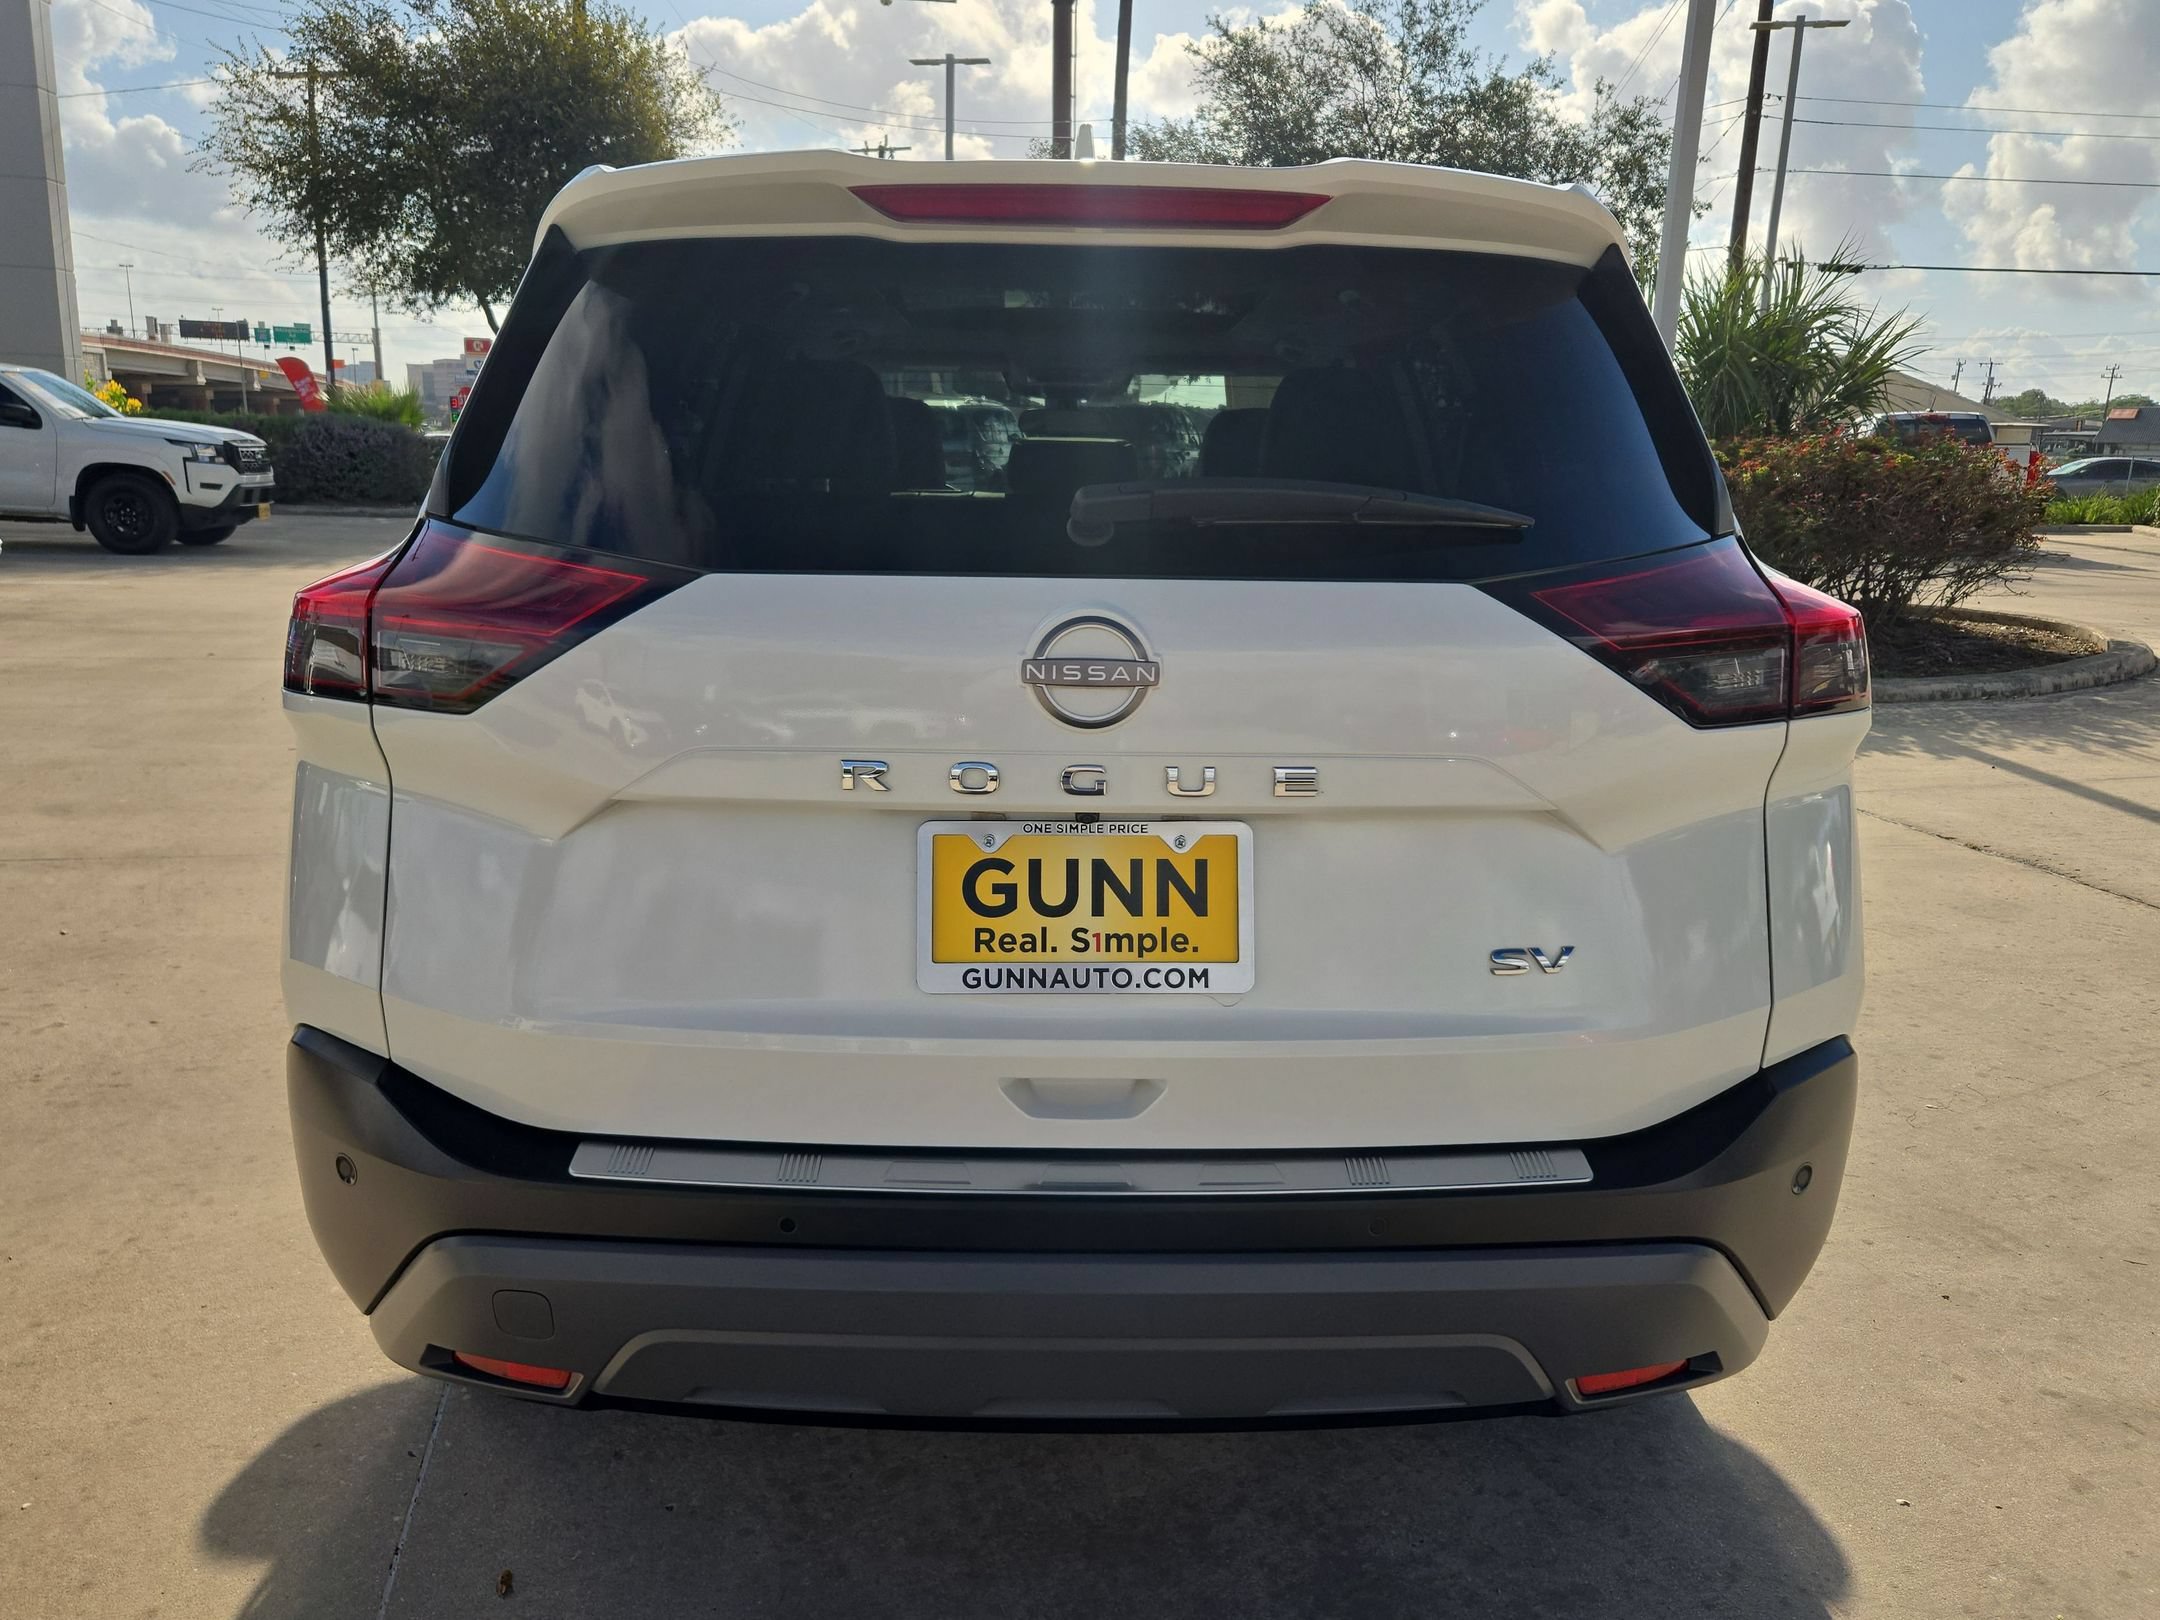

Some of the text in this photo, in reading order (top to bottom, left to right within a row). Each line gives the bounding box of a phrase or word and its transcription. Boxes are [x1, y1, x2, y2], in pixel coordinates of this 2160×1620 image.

[1025, 662, 1155, 683] NISSAN
[841, 759, 1320, 798] ROGUE
[1023, 823, 1148, 834] ONE SIMPLE PRICE
[962, 857, 1209, 918] GUNN
[974, 927, 1058, 954] Real.
[1490, 946, 1575, 976] SV
[962, 967, 1210, 990] GUNNAUTO.COM
